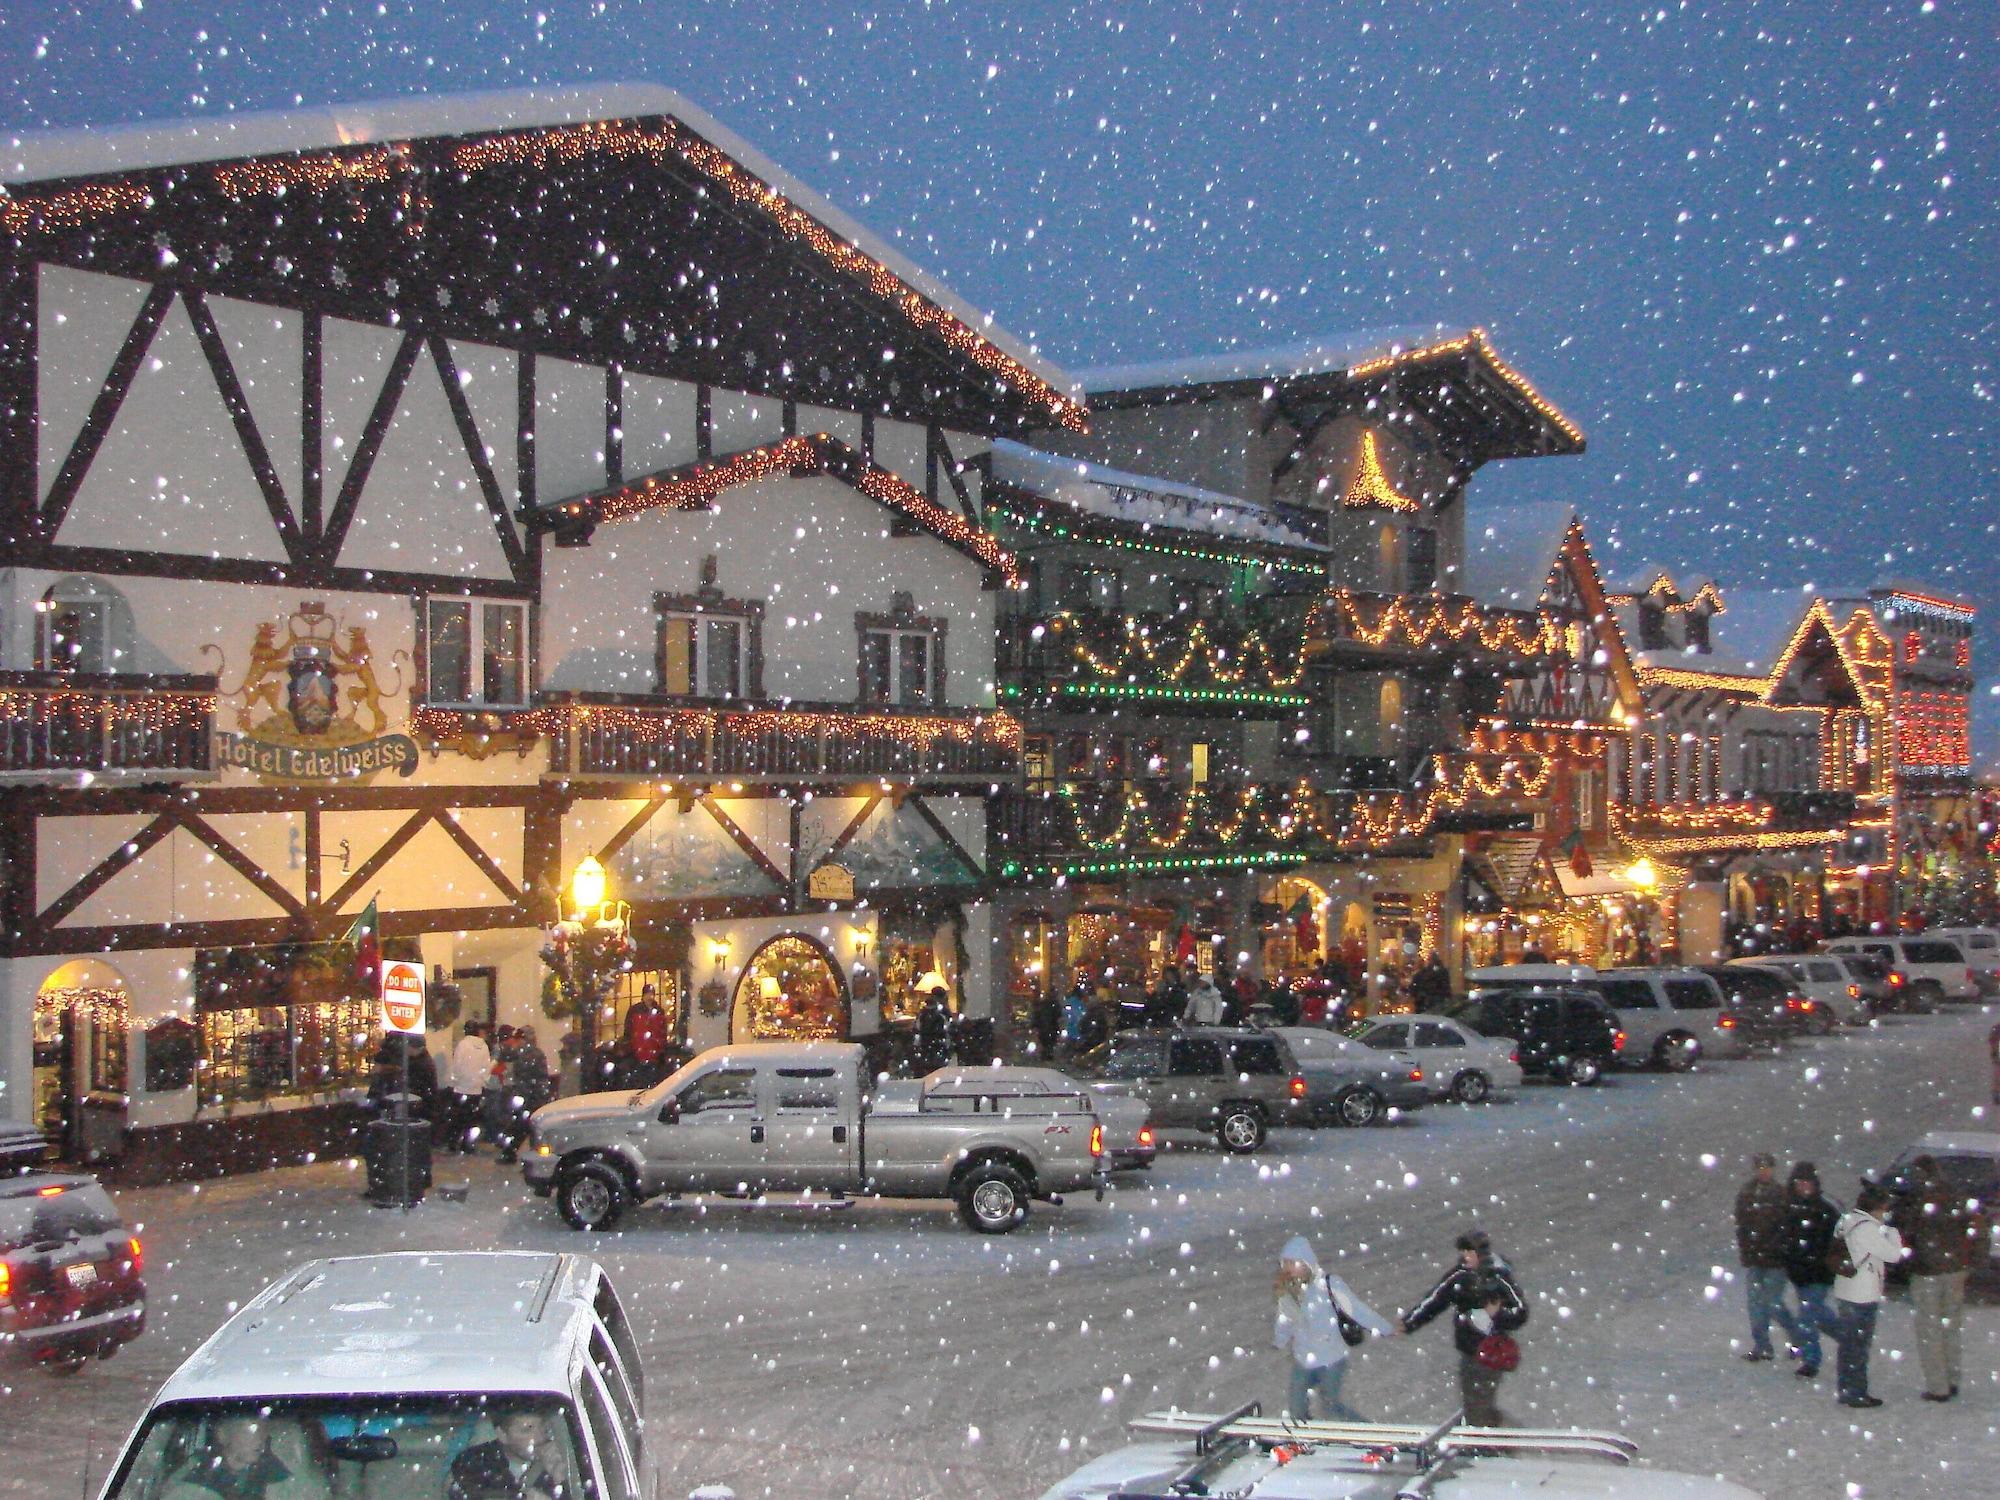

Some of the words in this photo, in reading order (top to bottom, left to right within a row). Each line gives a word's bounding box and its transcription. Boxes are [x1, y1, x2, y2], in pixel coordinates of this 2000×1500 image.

[216, 734, 282, 774] Hotel
[291, 742, 407, 777] Edelweiss
[389, 976, 400, 987] DO
[402, 977, 418, 989] NOT
[391, 1006, 416, 1019] ENTER
